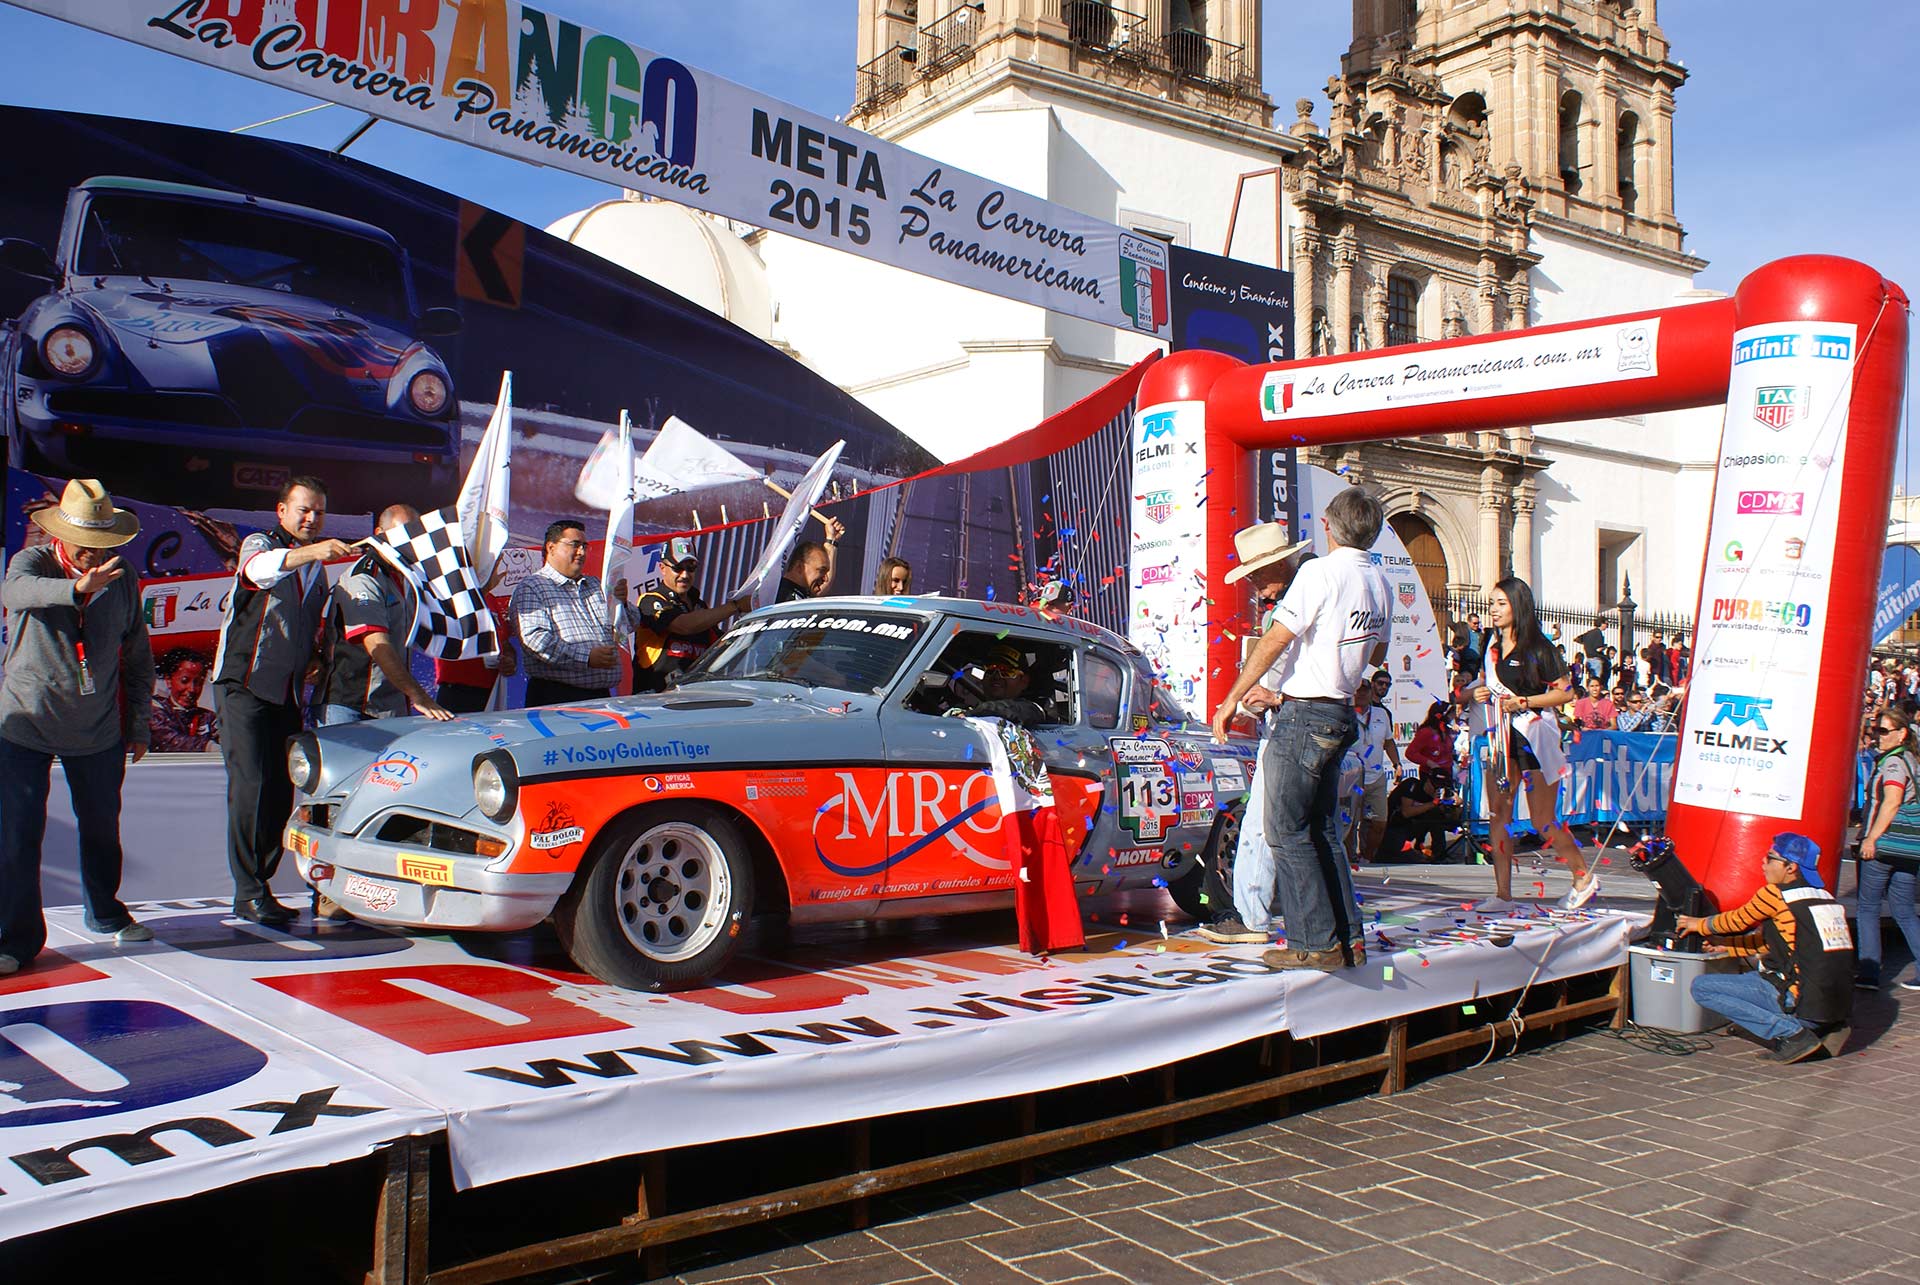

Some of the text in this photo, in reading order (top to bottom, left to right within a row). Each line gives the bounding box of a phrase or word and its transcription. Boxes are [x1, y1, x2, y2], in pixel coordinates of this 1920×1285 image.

[147, 0, 711, 195] La Carrera Panamericana
[751, 107, 887, 200] META
[768, 178, 872, 245] 2015
[910, 168, 1087, 256] La Carrera
[898, 205, 1101, 299] Panamericana
[1182, 272, 1290, 309] Conóceme y Enamórate
[1735, 335, 1850, 364] infinitm
[1301, 376, 1326, 396] La
[1332, 372, 1395, 396] Carrera
[1756, 406, 1797, 431] HEUE
[1723, 453, 1808, 469] Chiapasione
[1146, 503, 1173, 523] HEUE
[184, 591, 211, 611] La
[1401, 585, 1414, 593] TAG
[1711, 622, 1809, 636] www.visitadurgo.mx
[1694, 730, 1789, 755] TELMEX
[1699, 751, 1774, 771] está contigo
[665, 774, 691, 782] OPTICAS
[665, 782, 696, 790] AMERICA
[1123, 780, 1173, 807] 113
[835, 771, 1006, 848] MRC
[402, 859, 448, 882] PIRELLI
[808, 875, 1016, 900] Manejo de Recursos y Controles Intelig
[464, 953, 1284, 1089] www.visitad
